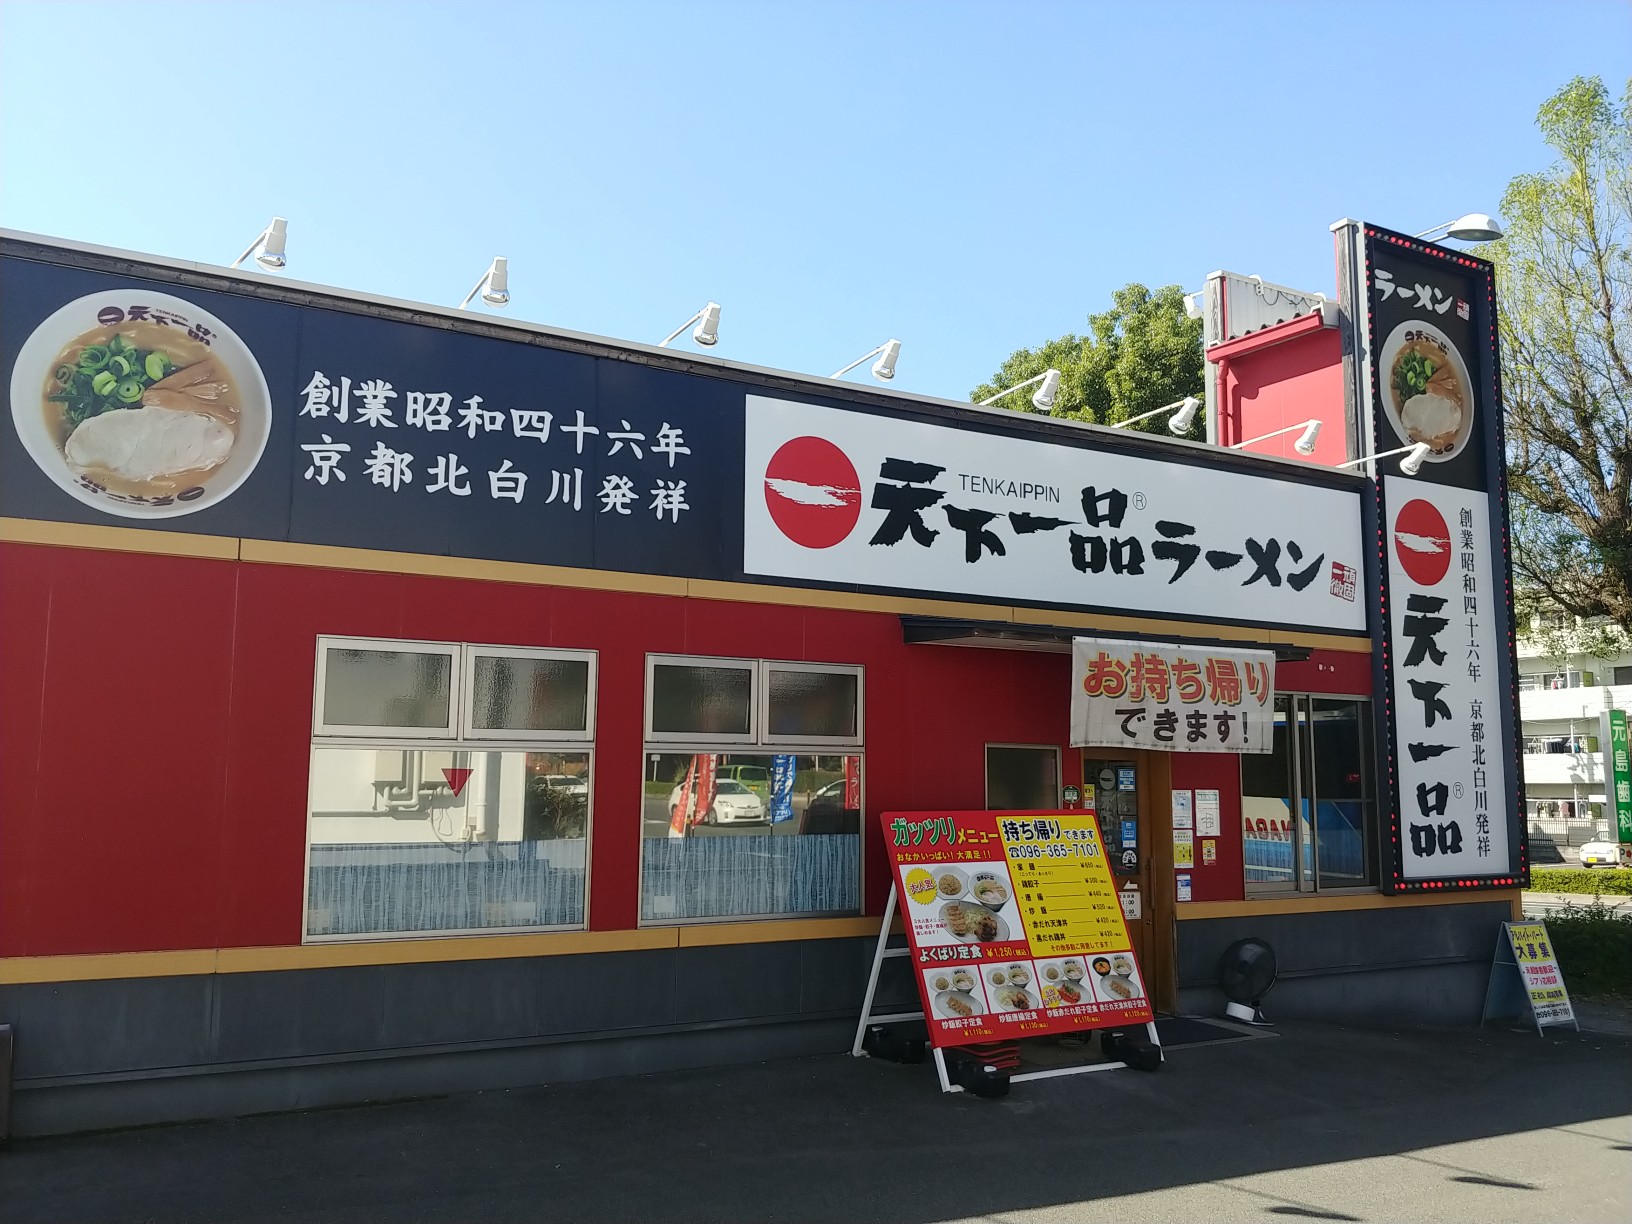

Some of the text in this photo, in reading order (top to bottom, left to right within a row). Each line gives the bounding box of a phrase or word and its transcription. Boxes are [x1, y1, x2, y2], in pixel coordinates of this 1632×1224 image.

[1375, 268, 1453, 315] ラーメン
[299, 369, 693, 469] 創業昭和四十六年
[301, 434, 692, 524] 京都北白川発祥
[958, 473, 1061, 503] TENKAIPPIN
[1082, 651, 1270, 706] お持ち帰り
[1459, 507, 1491, 858] 創業昭和四十六年 京都北白川発祥
[1402, 593, 1463, 858] 天下一品
[1514, 941, 1551, 960] 大募集
